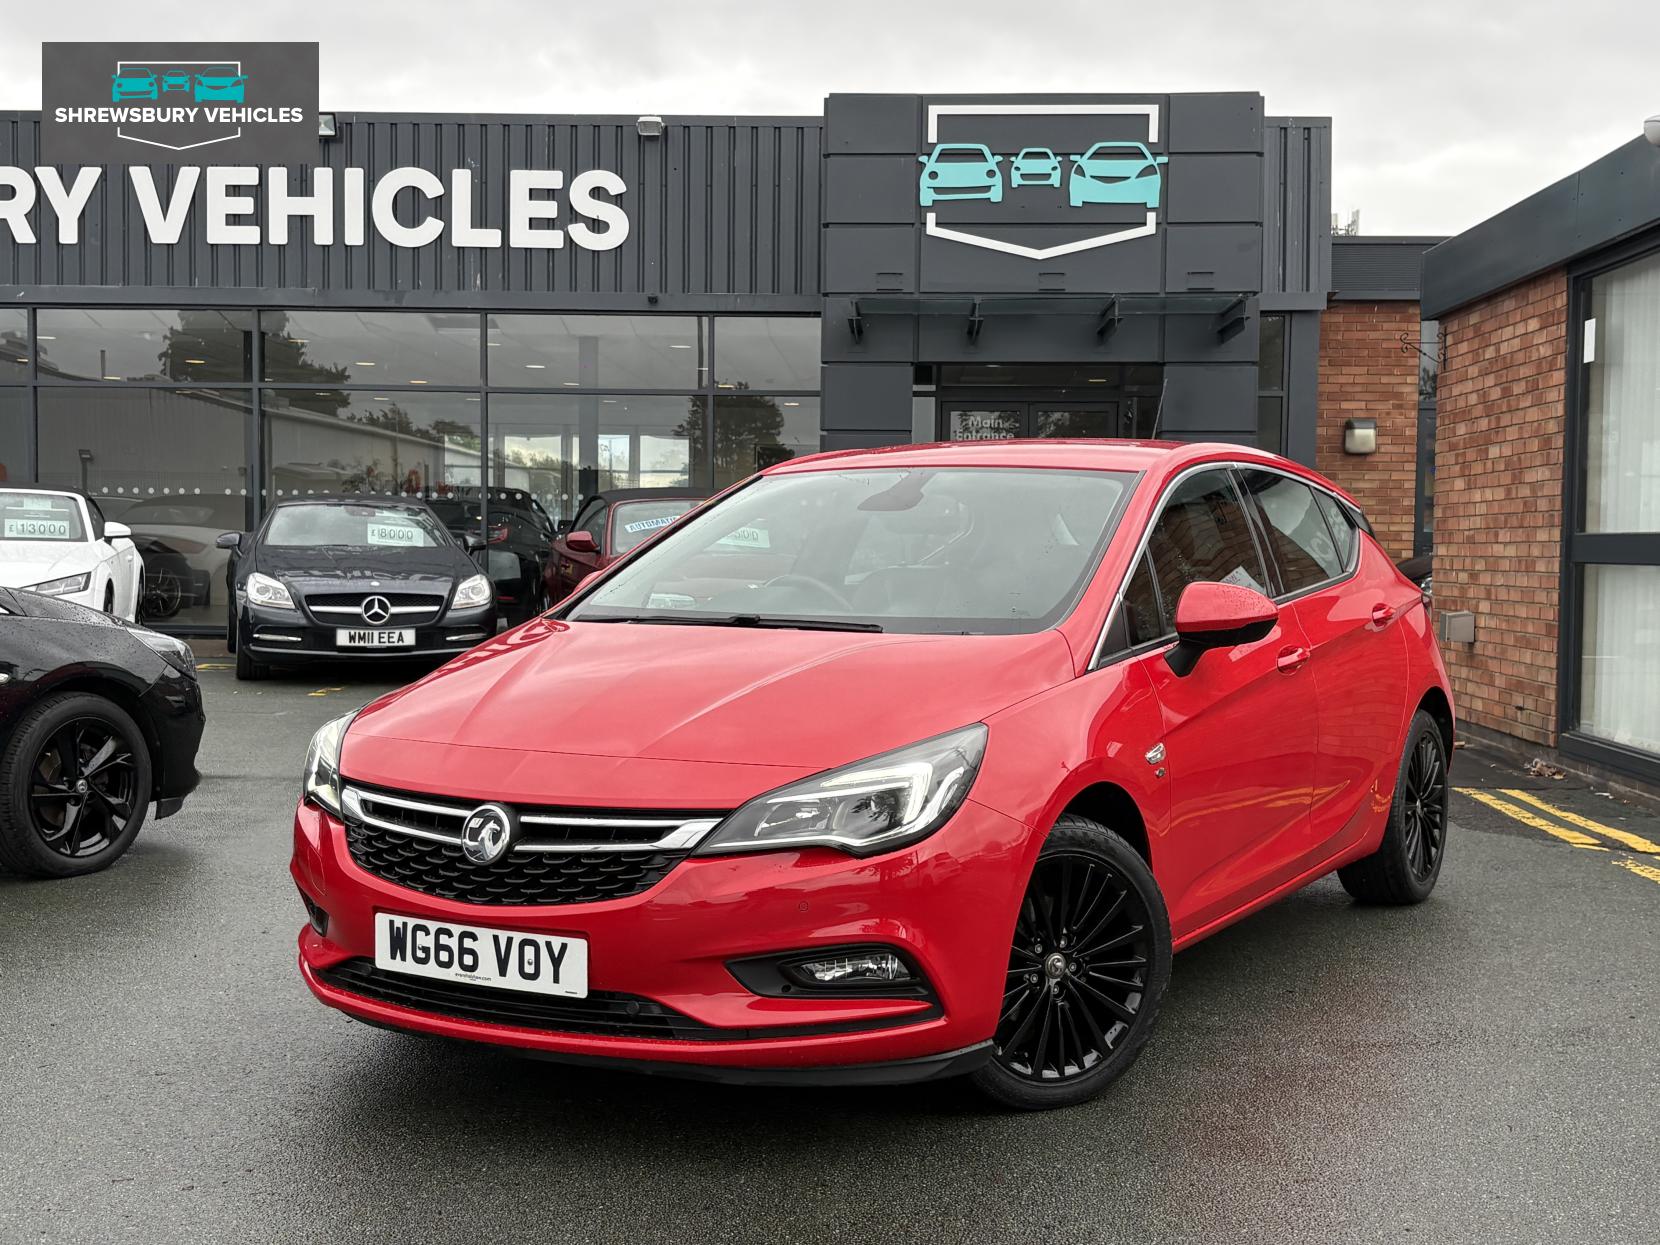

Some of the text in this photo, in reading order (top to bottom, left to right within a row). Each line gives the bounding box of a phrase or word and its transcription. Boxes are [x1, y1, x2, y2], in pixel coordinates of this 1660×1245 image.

[128, 166, 630, 251] VEHICLES
[969, 416, 1003, 428] Main
[348, 631, 405, 644] WM11 EEA
[389, 919, 568, 984] WG66 VOY
